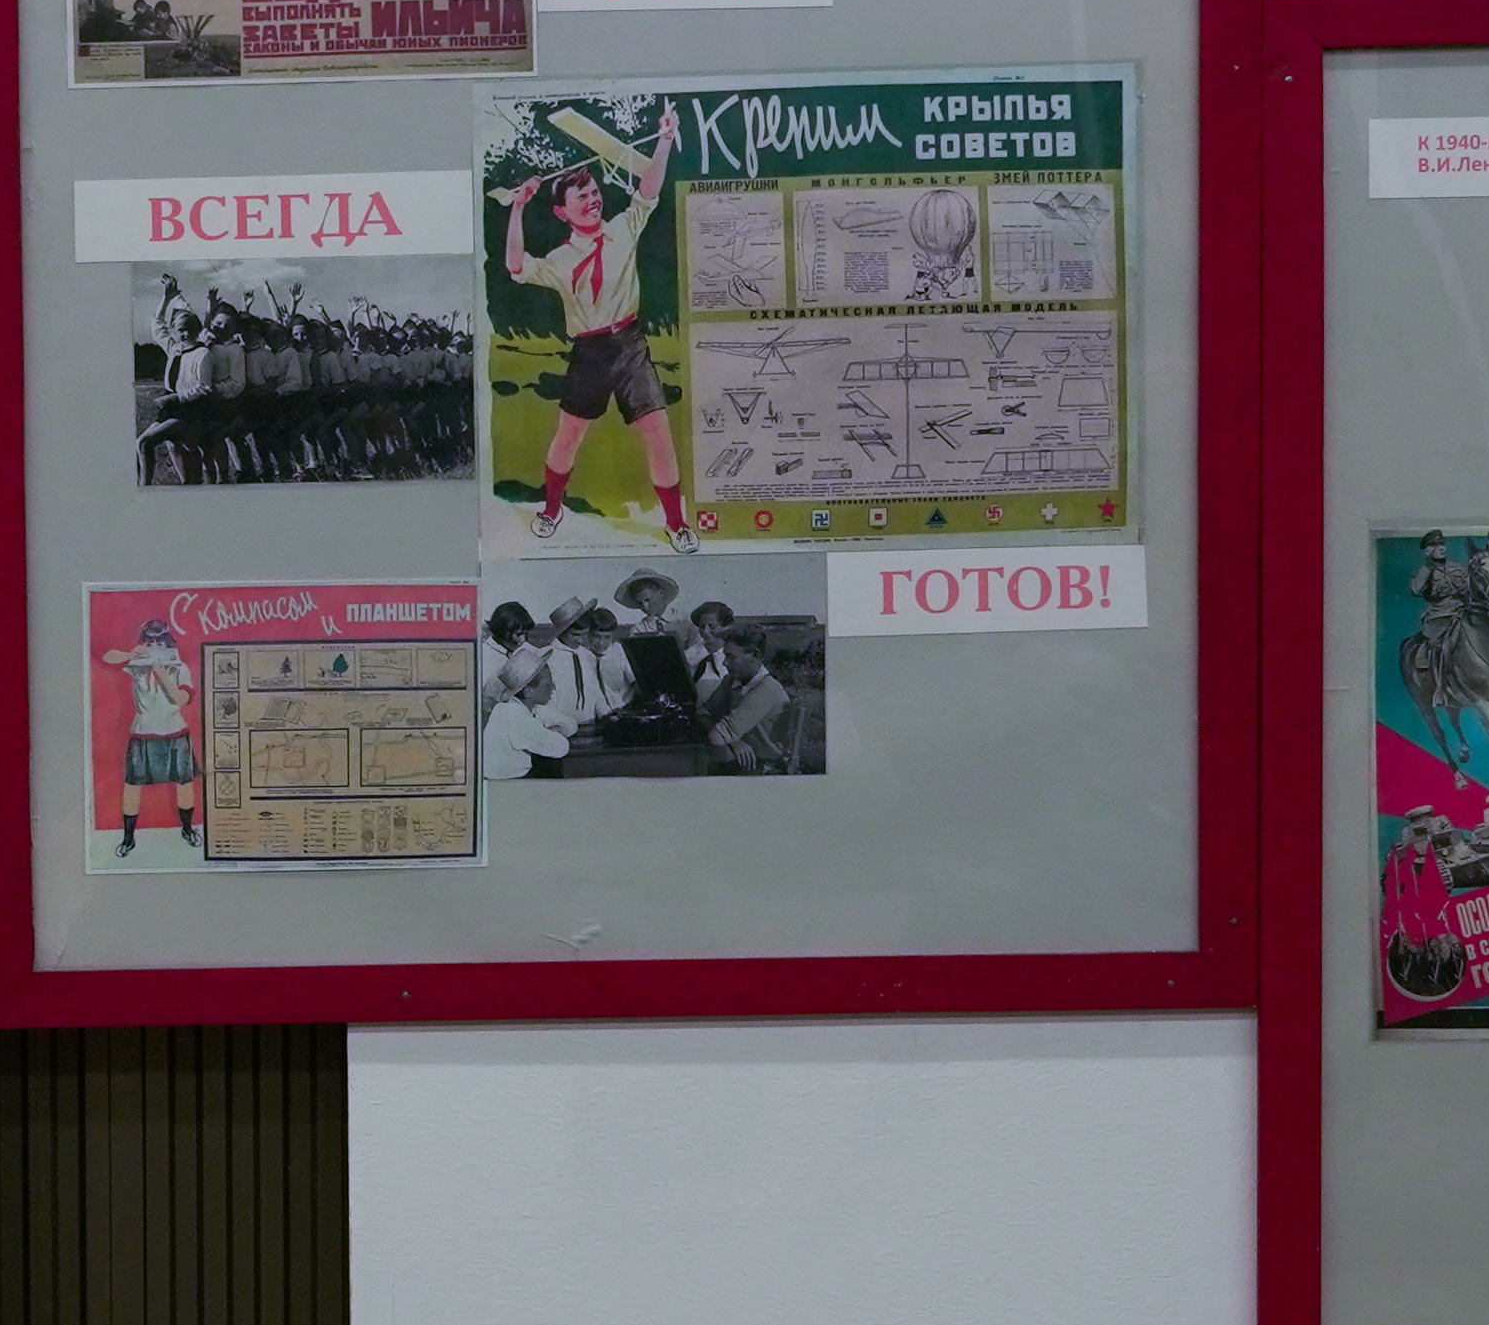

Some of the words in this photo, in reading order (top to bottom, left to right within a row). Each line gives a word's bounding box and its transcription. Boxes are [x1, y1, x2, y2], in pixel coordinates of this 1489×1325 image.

[242, 3, 361, 21] ВЫПОЛНЯТЬ
[242, 22, 360, 42] ЗАВЕТЫ
[692, 94, 903, 177] Крепим
[925, 92, 1071, 122] КРЫЛЬЯ
[916, 131, 1077, 160] СОВЕТОВ
[1418, 135, 1429, 151] К
[149, 192, 402, 248] ВСЕГДА
[879, 563, 1111, 616] ГОТОВ!
[345, 600, 472, 624] ПЛАНШЕТОМ
[1469, 943, 1476, 960] В
